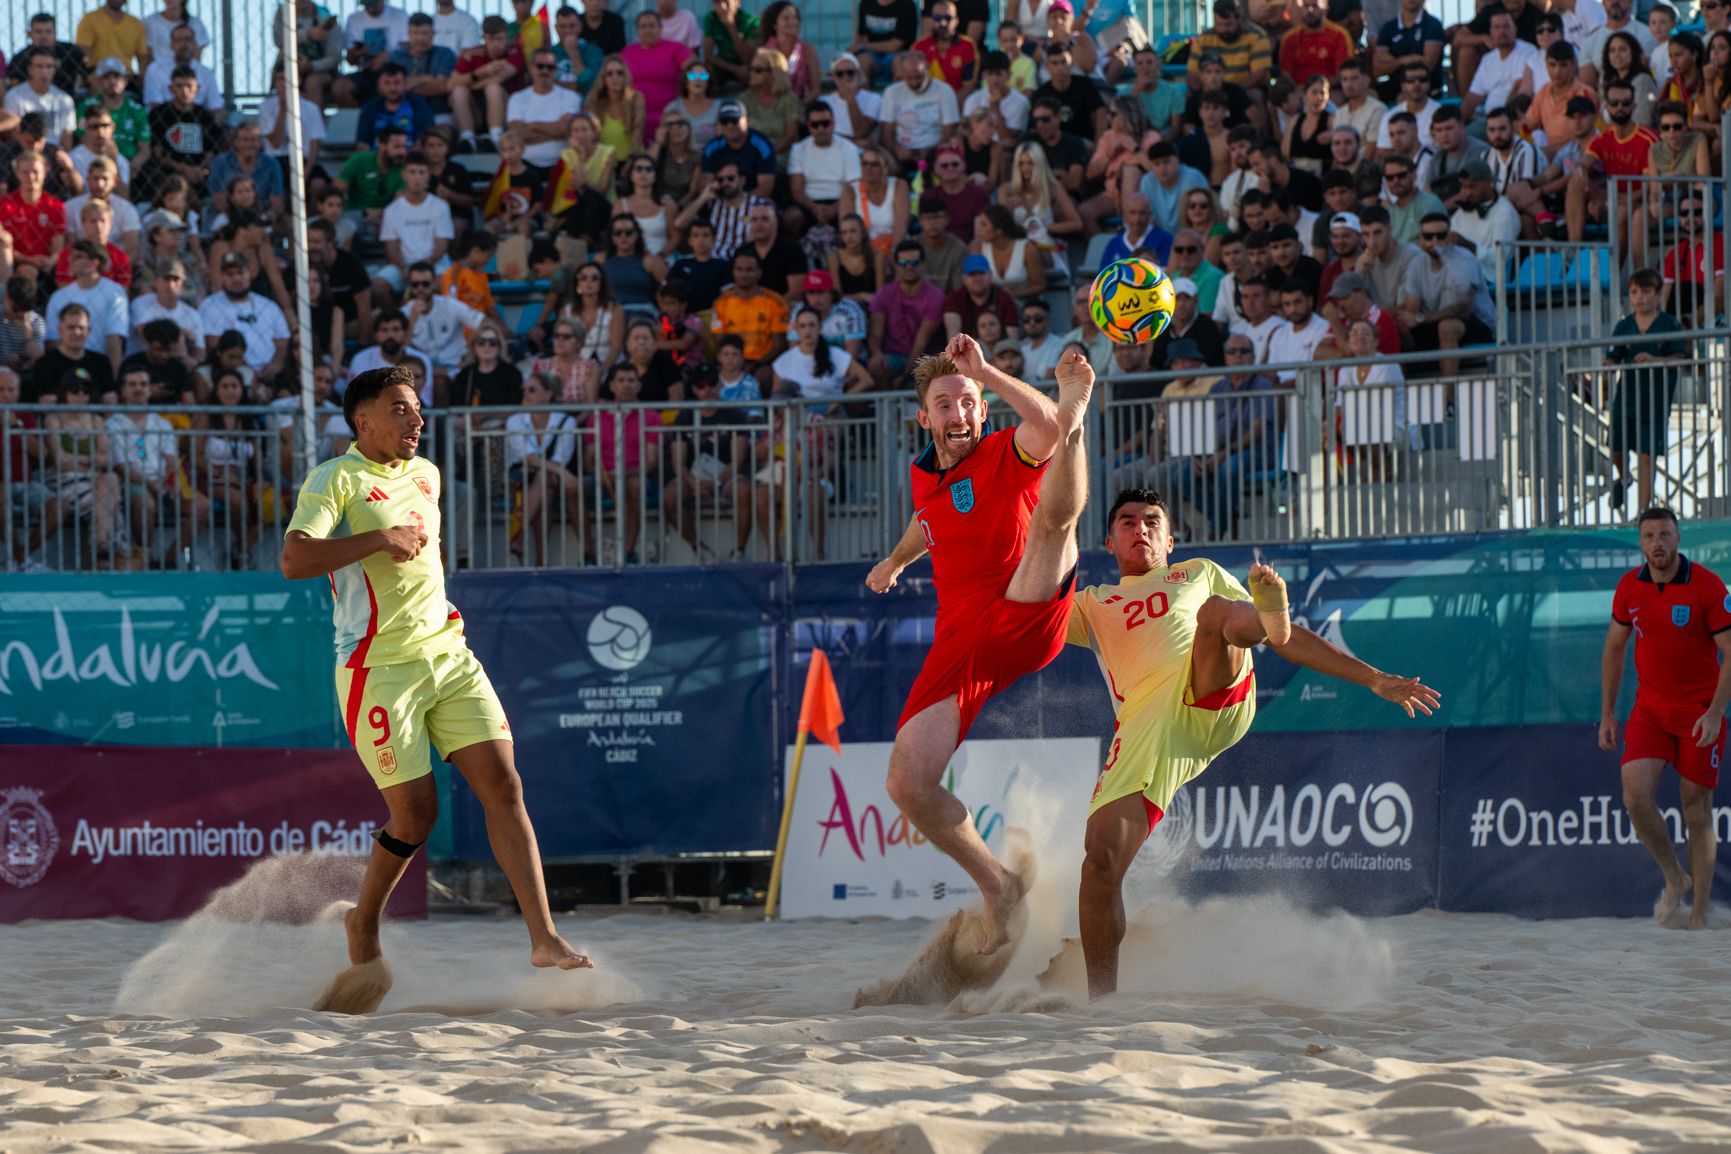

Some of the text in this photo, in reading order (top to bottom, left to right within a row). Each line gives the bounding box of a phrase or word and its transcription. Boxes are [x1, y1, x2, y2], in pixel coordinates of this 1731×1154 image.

[1123, 592, 1169, 631] 20
[0, 605, 281, 697] ndalucía
[629, 685, 664, 697] SOCCER
[584, 699, 615, 710] WORLD
[616, 698, 634, 709] CUP
[368, 705, 391, 747] 9
[559, 710, 683, 728] EUROPEAN QUALIFIER
[605, 747, 638, 763] CÁDIZ
[1711, 744, 1719, 768] 6
[1195, 782, 1357, 850] UNAOC
[71, 818, 376, 864] Ayuntamiento de Cádi
[1223, 853, 1264, 870] Nations
[1266, 852, 1314, 869] Alliance
[1316, 852, 1329, 868] of
[1331, 850, 1413, 871] Civilizations
